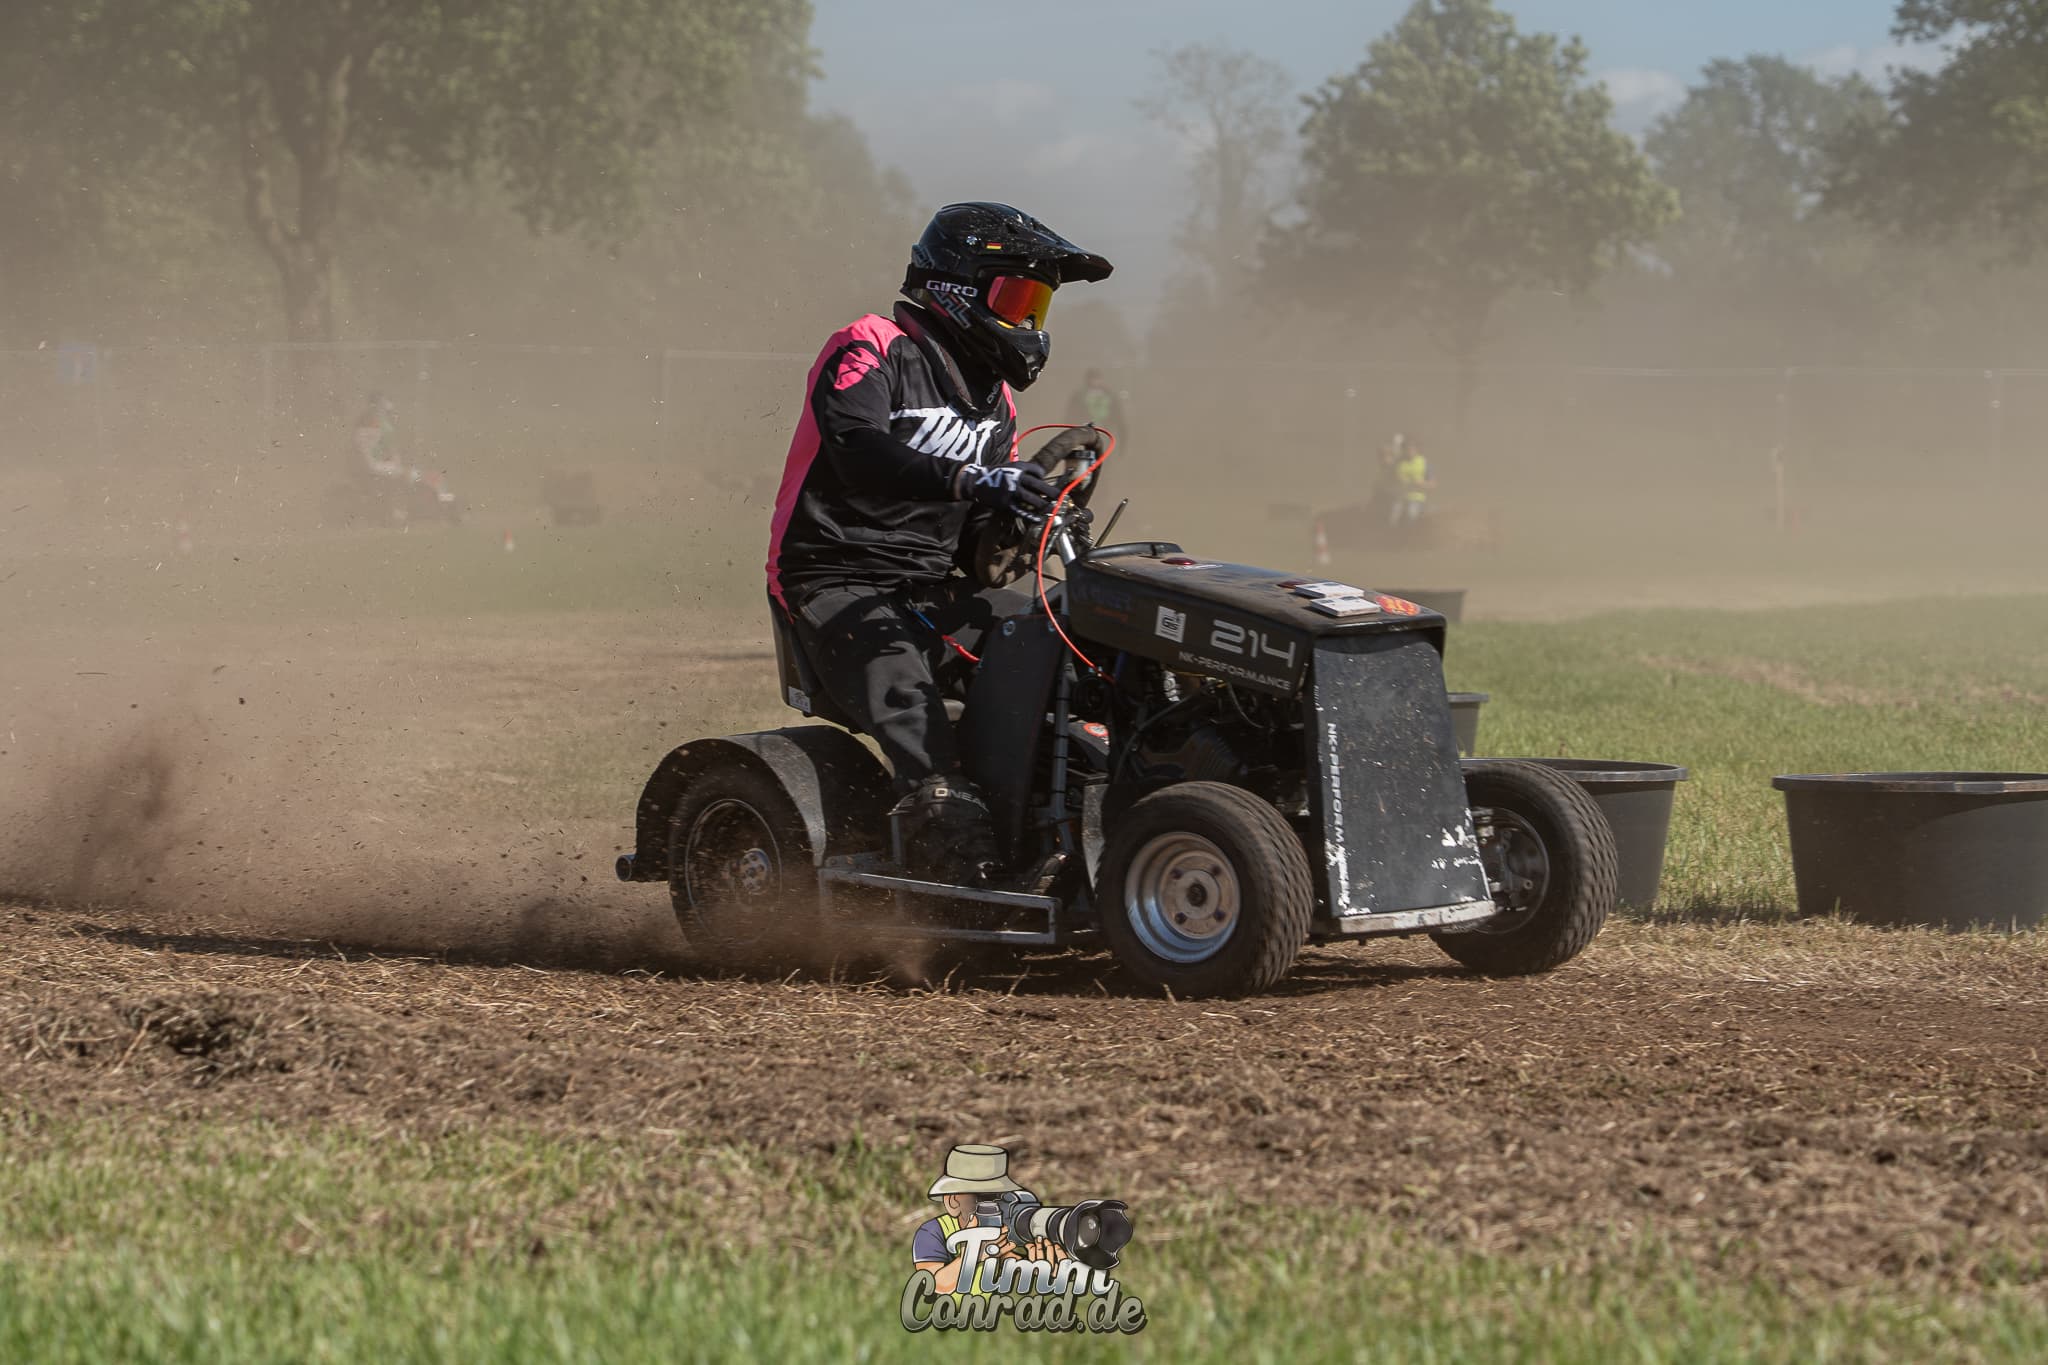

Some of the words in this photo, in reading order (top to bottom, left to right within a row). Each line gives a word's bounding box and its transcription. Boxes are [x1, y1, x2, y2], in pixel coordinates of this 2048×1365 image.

[926, 280, 978, 298] GIRO
[1211, 619, 1296, 668] 214
[1179, 651, 1292, 691] NK-PERFORMANCE
[1327, 722, 1350, 907] NK-PERFORM
